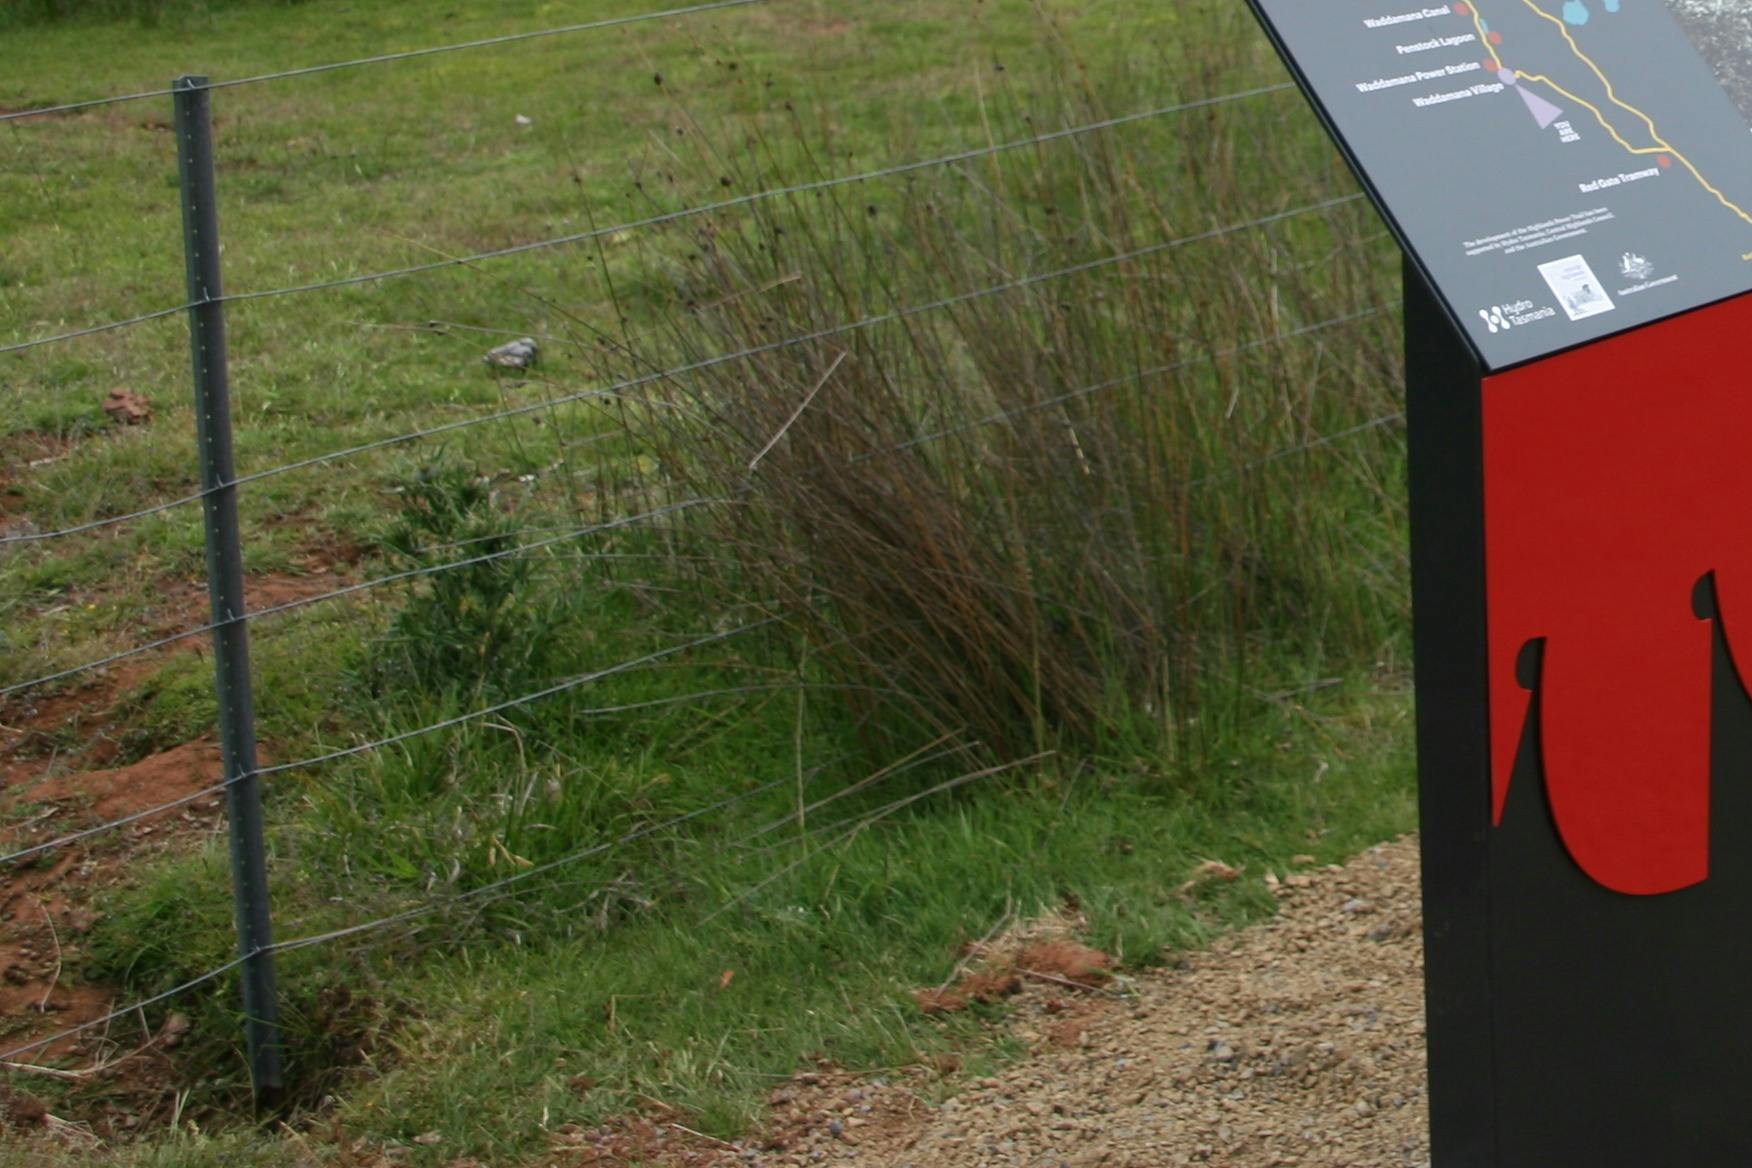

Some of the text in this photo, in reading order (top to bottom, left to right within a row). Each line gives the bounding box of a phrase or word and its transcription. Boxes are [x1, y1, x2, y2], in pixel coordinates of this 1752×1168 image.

[1363, 4, 1451, 28] Waddamana Canal
[1395, 33, 1476, 54] Penstock Lagoon
[1355, 61, 1481, 92] Waddamana Power Station
[1412, 89, 1473, 107] Waddamana
[1579, 179, 1600, 193] Red
[1501, 299, 1534, 315] Hydro
[1509, 306, 1556, 326] Tasmania
